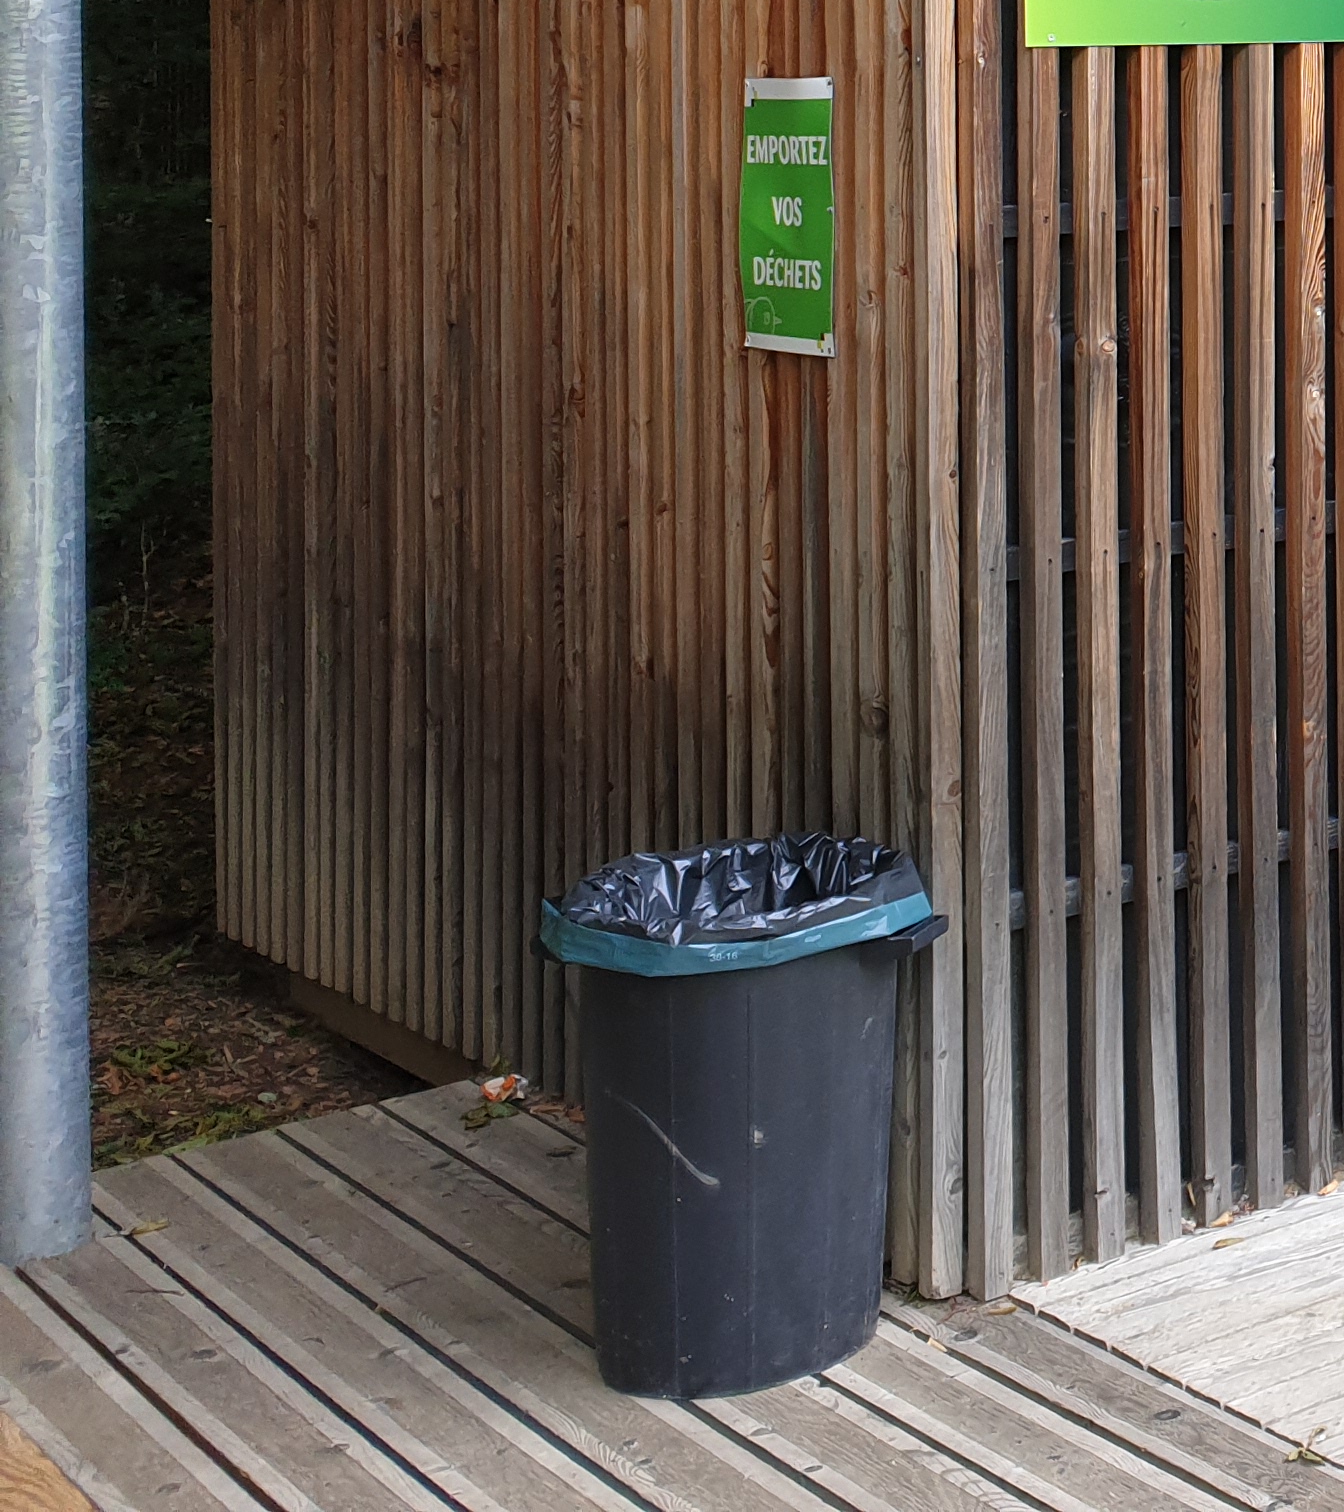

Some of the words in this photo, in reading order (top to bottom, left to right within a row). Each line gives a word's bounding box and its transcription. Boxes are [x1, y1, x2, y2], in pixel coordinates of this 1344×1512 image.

[746, 135, 828, 165] EMPORTEZ
[771, 196, 803, 227] VOS
[753, 248, 821, 291] DÉCHETS
